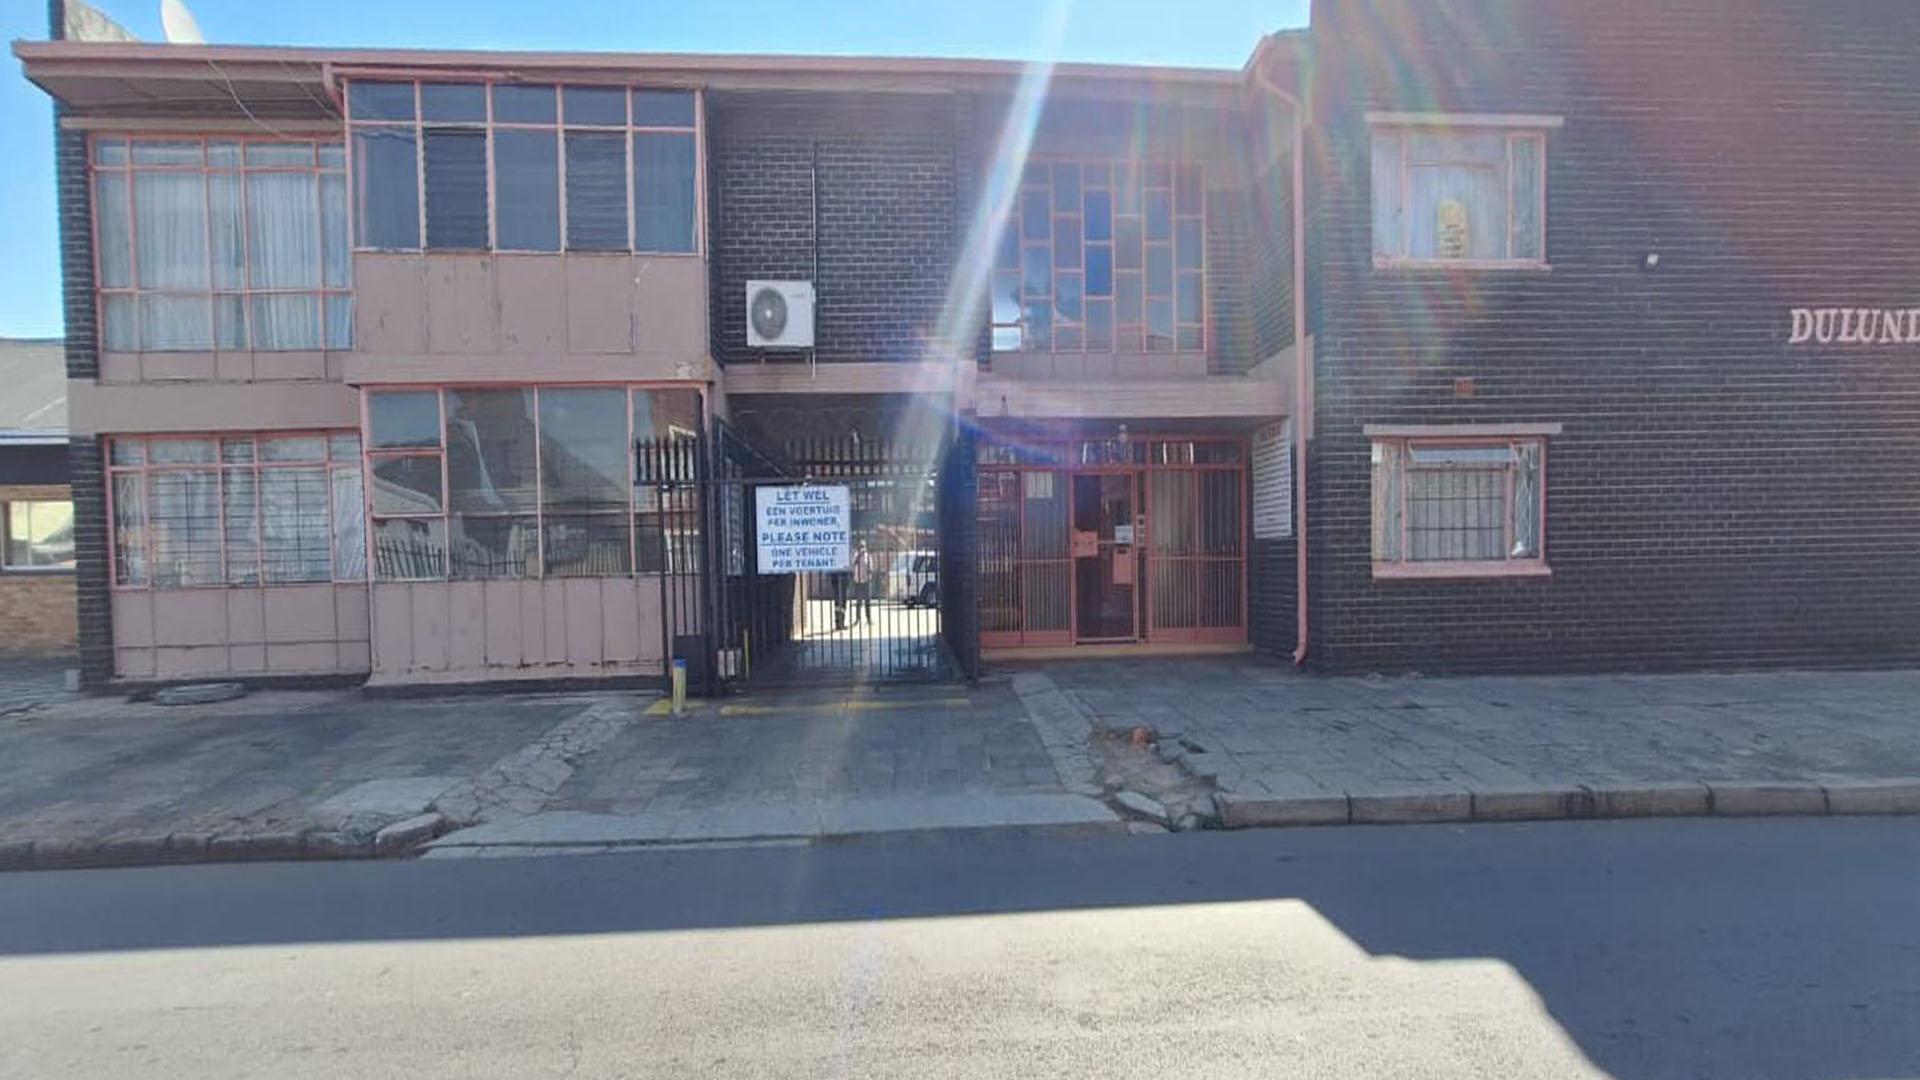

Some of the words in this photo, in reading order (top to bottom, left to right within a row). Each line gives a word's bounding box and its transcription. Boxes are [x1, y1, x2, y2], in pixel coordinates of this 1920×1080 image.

[776, 491, 799, 501] LET
[803, 490, 830, 501] WEL
[766, 506, 786, 516] EEN
[767, 517, 787, 527] PER
[762, 531, 808, 542] PLEASE
[813, 531, 846, 541] NOTE
[771, 547, 791, 557] ONE
[795, 546, 837, 556] VEHICLE
[772, 559, 792, 568] PER
